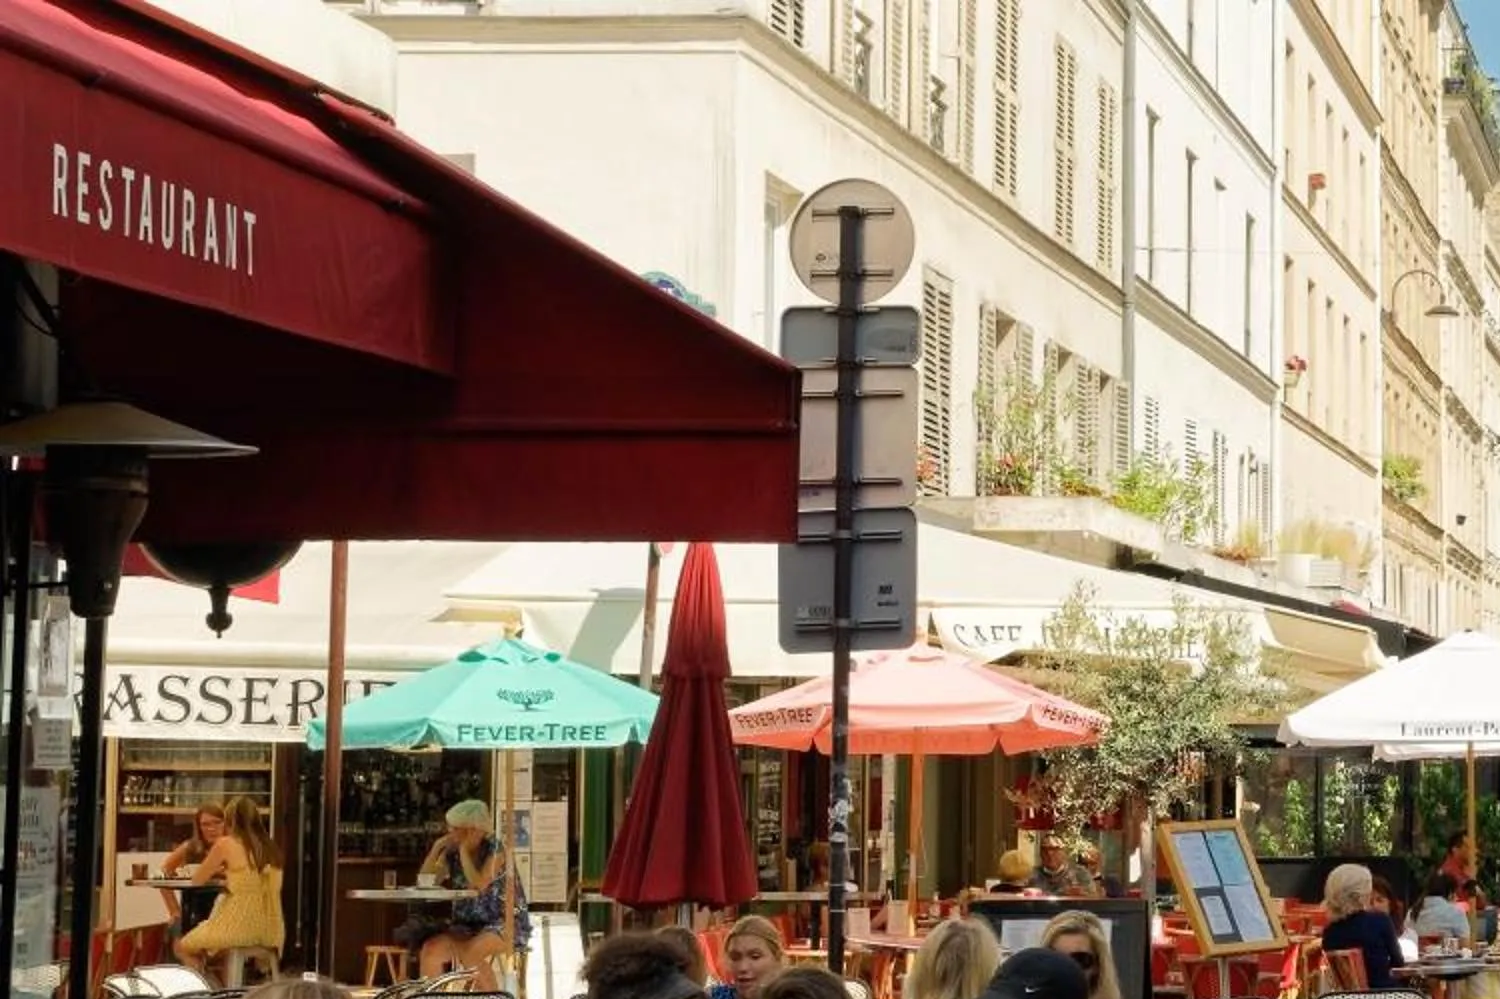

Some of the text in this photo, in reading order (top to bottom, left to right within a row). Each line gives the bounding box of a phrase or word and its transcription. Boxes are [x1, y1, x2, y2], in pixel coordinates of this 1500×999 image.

[53, 143, 256, 276] RESTAURANT
[735, 707, 813, 729] FEVER-TREE
[457, 723, 607, 742] FEVER-TREE
